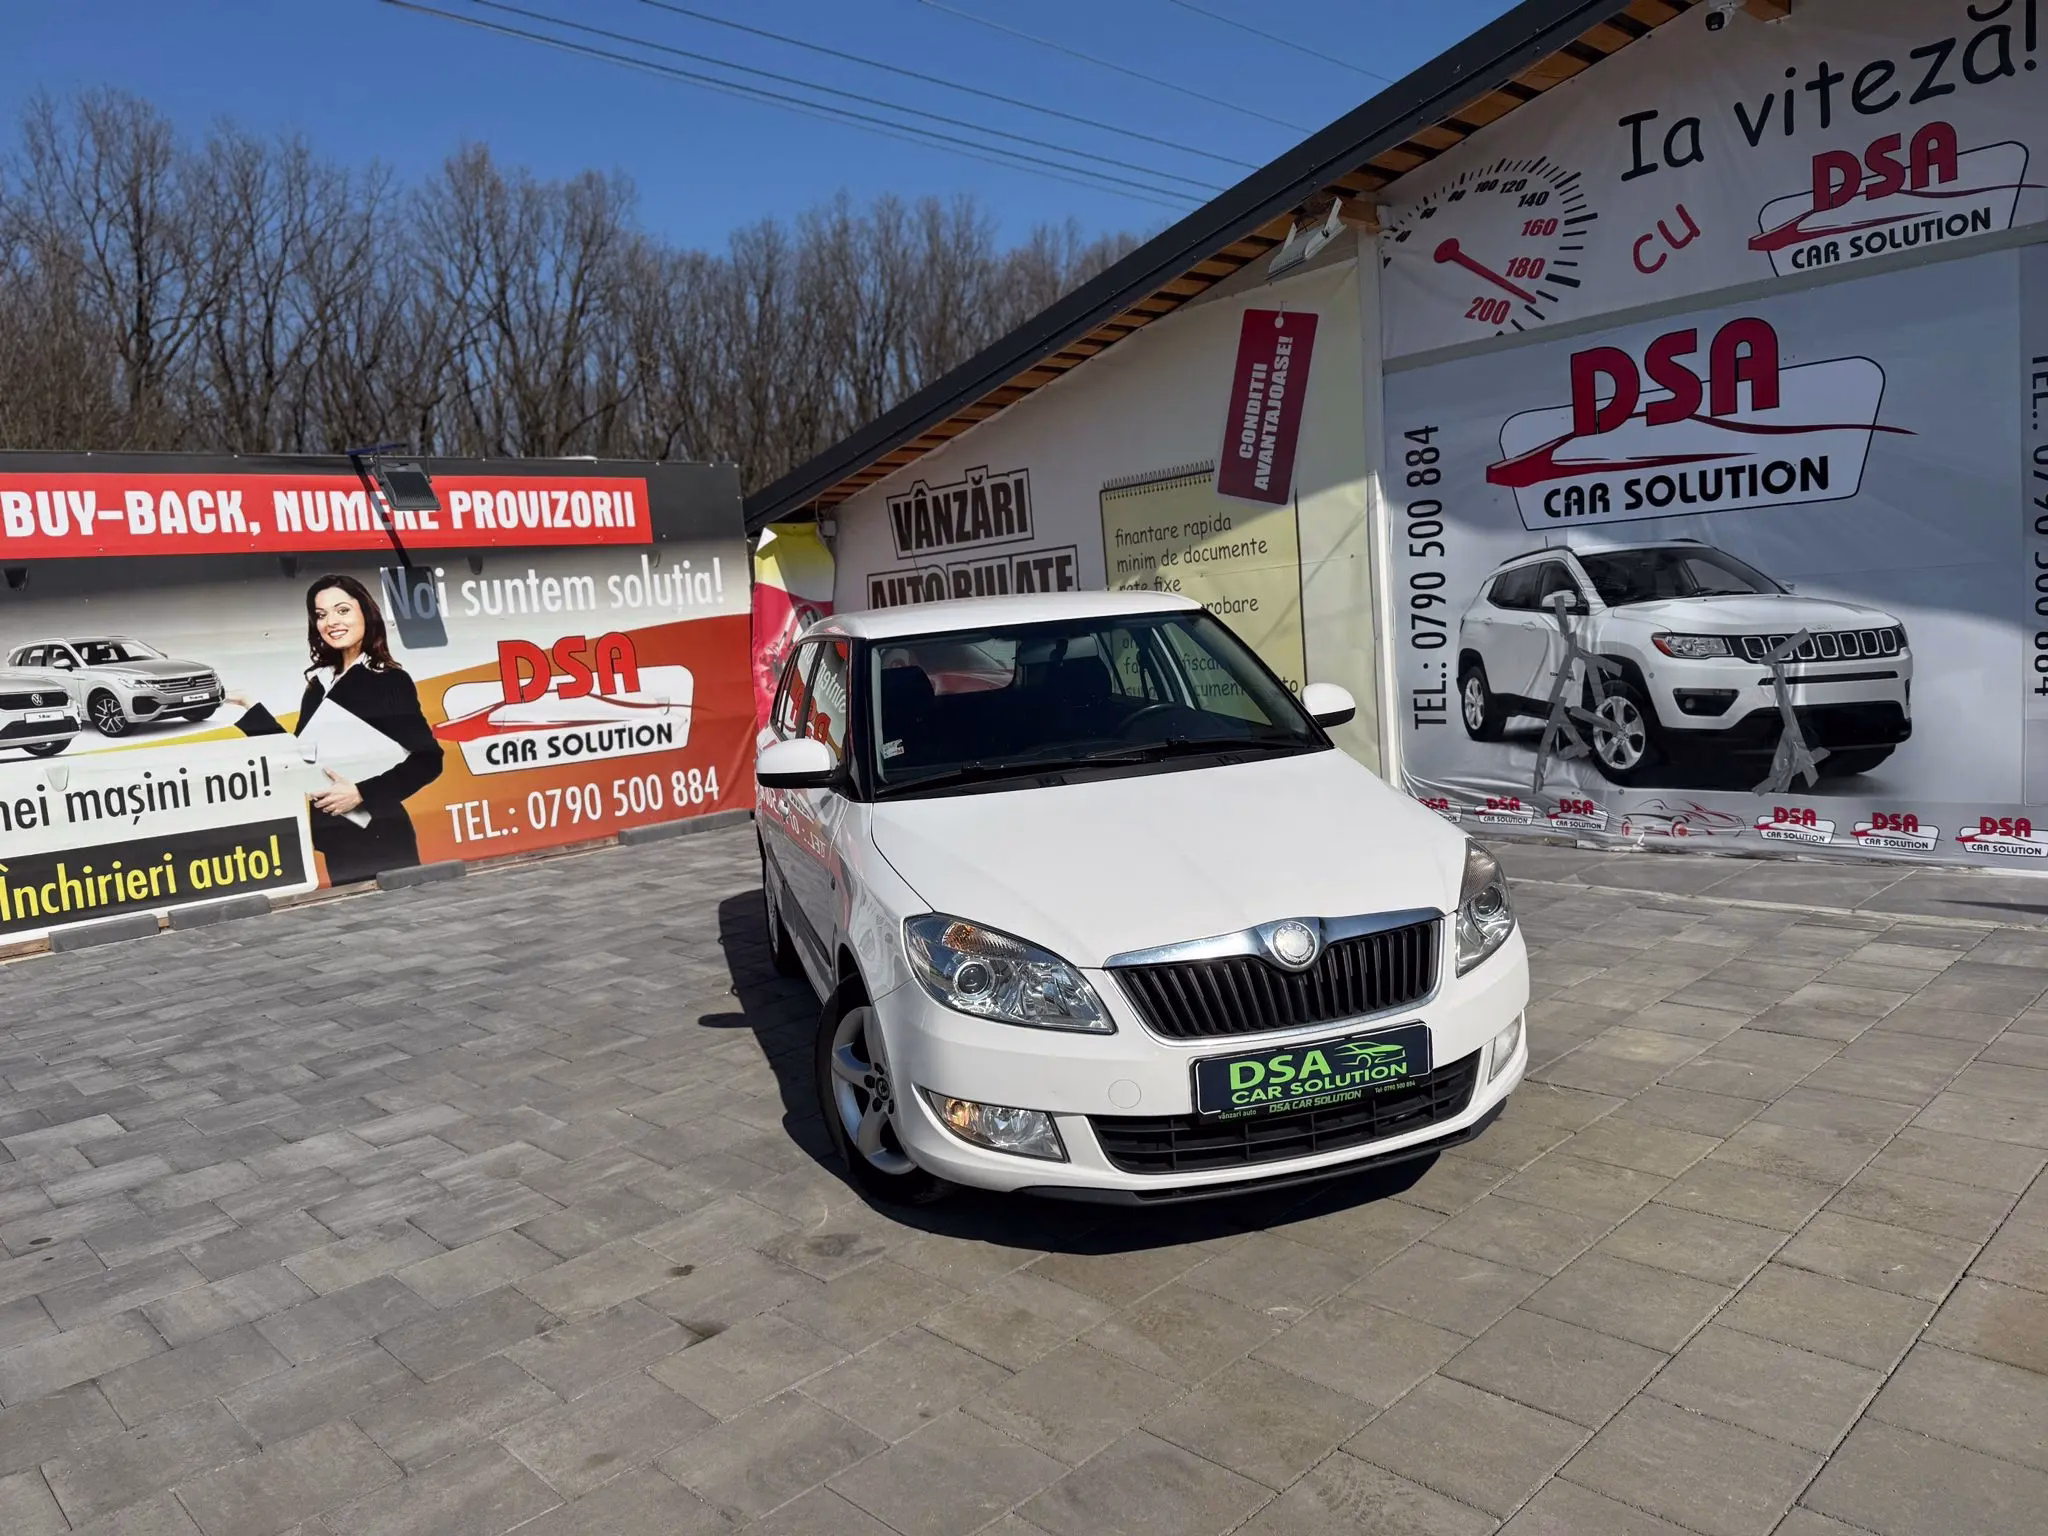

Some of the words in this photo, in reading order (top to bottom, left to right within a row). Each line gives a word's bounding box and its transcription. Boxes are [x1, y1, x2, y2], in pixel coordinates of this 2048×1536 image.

[1618, 109, 1704, 182] Ia
[1812, 120, 1958, 213] DSA
[1500, 178, 1528, 194] 120
[1517, 191, 1550, 208] 140
[1521, 218, 1558, 237] 160
[1633, 203, 1702, 275] cu
[1791, 240, 1840, 270] CAR
[1849, 206, 1992, 259] SOLUTION
[1505, 257, 1545, 280] 180
[1464, 296, 1511, 325] 200
[1570, 316, 1781, 438] DSA
[1254, 335, 1294, 491] AVANTAJOASE!
[1404, 425, 1443, 488] 884
[1543, 482, 1610, 519] CAR
[1623, 454, 1831, 511] SOLUTION
[449, 489, 637, 531] PROVIZORII
[891, 475, 1029, 551] VÂNZĂRI
[1115, 525, 1178, 548] finantare
[1183, 512, 1232, 541] rapida
[1406, 499, 1446, 558] 500
[1116, 552, 1157, 573] minim
[1161, 548, 1179, 568] de
[1183, 538, 1268, 564] documente
[379, 566, 449, 621] Noi
[461, 568, 596, 617] suntem
[1154, 576, 1182, 592] fixe
[1409, 570, 1448, 651] 0790
[497, 631, 641, 706] DSA
[1413, 662, 1449, 731] TEL.:
[485, 739, 538, 766] CAR
[547, 722, 673, 758] SOLUTION
[205, 756, 272, 804] noi!
[445, 799, 519, 844] TEL.:
[527, 782, 603, 831] 0790
[613, 773, 664, 818] 500
[671, 766, 720, 807] 884
[1486, 796, 1521, 811] DSA
[1497, 815, 1528, 825] SOLUTION
[1559, 799, 1595, 815] DSA
[1773, 806, 1817, 827] DSA
[1872, 812, 1919, 833] DSA
[1569, 821, 1602, 831] SOLUTION
[1766, 831, 1782, 840] CAR
[1783, 831, 1826, 843] SOLUTION
[1864, 837, 1882, 847] CAR
[1883, 838, 1929, 850] SOLUTION
[1979, 816, 2032, 838] DSA
[189, 835, 283, 889] auto!
[1971, 843, 1990, 853] CAR
[1992, 844, 2042, 856] SOLUTION
[1229, 1049, 1333, 1091] DSA
[1231, 1085, 1284, 1105] CAR
[1290, 1061, 1408, 1096] SOLUTION
[1269, 1102, 1291, 1114] DSA
[1292, 1098, 1314, 1111] CAR
[1314, 1089, 1363, 1107] SOLUTION
